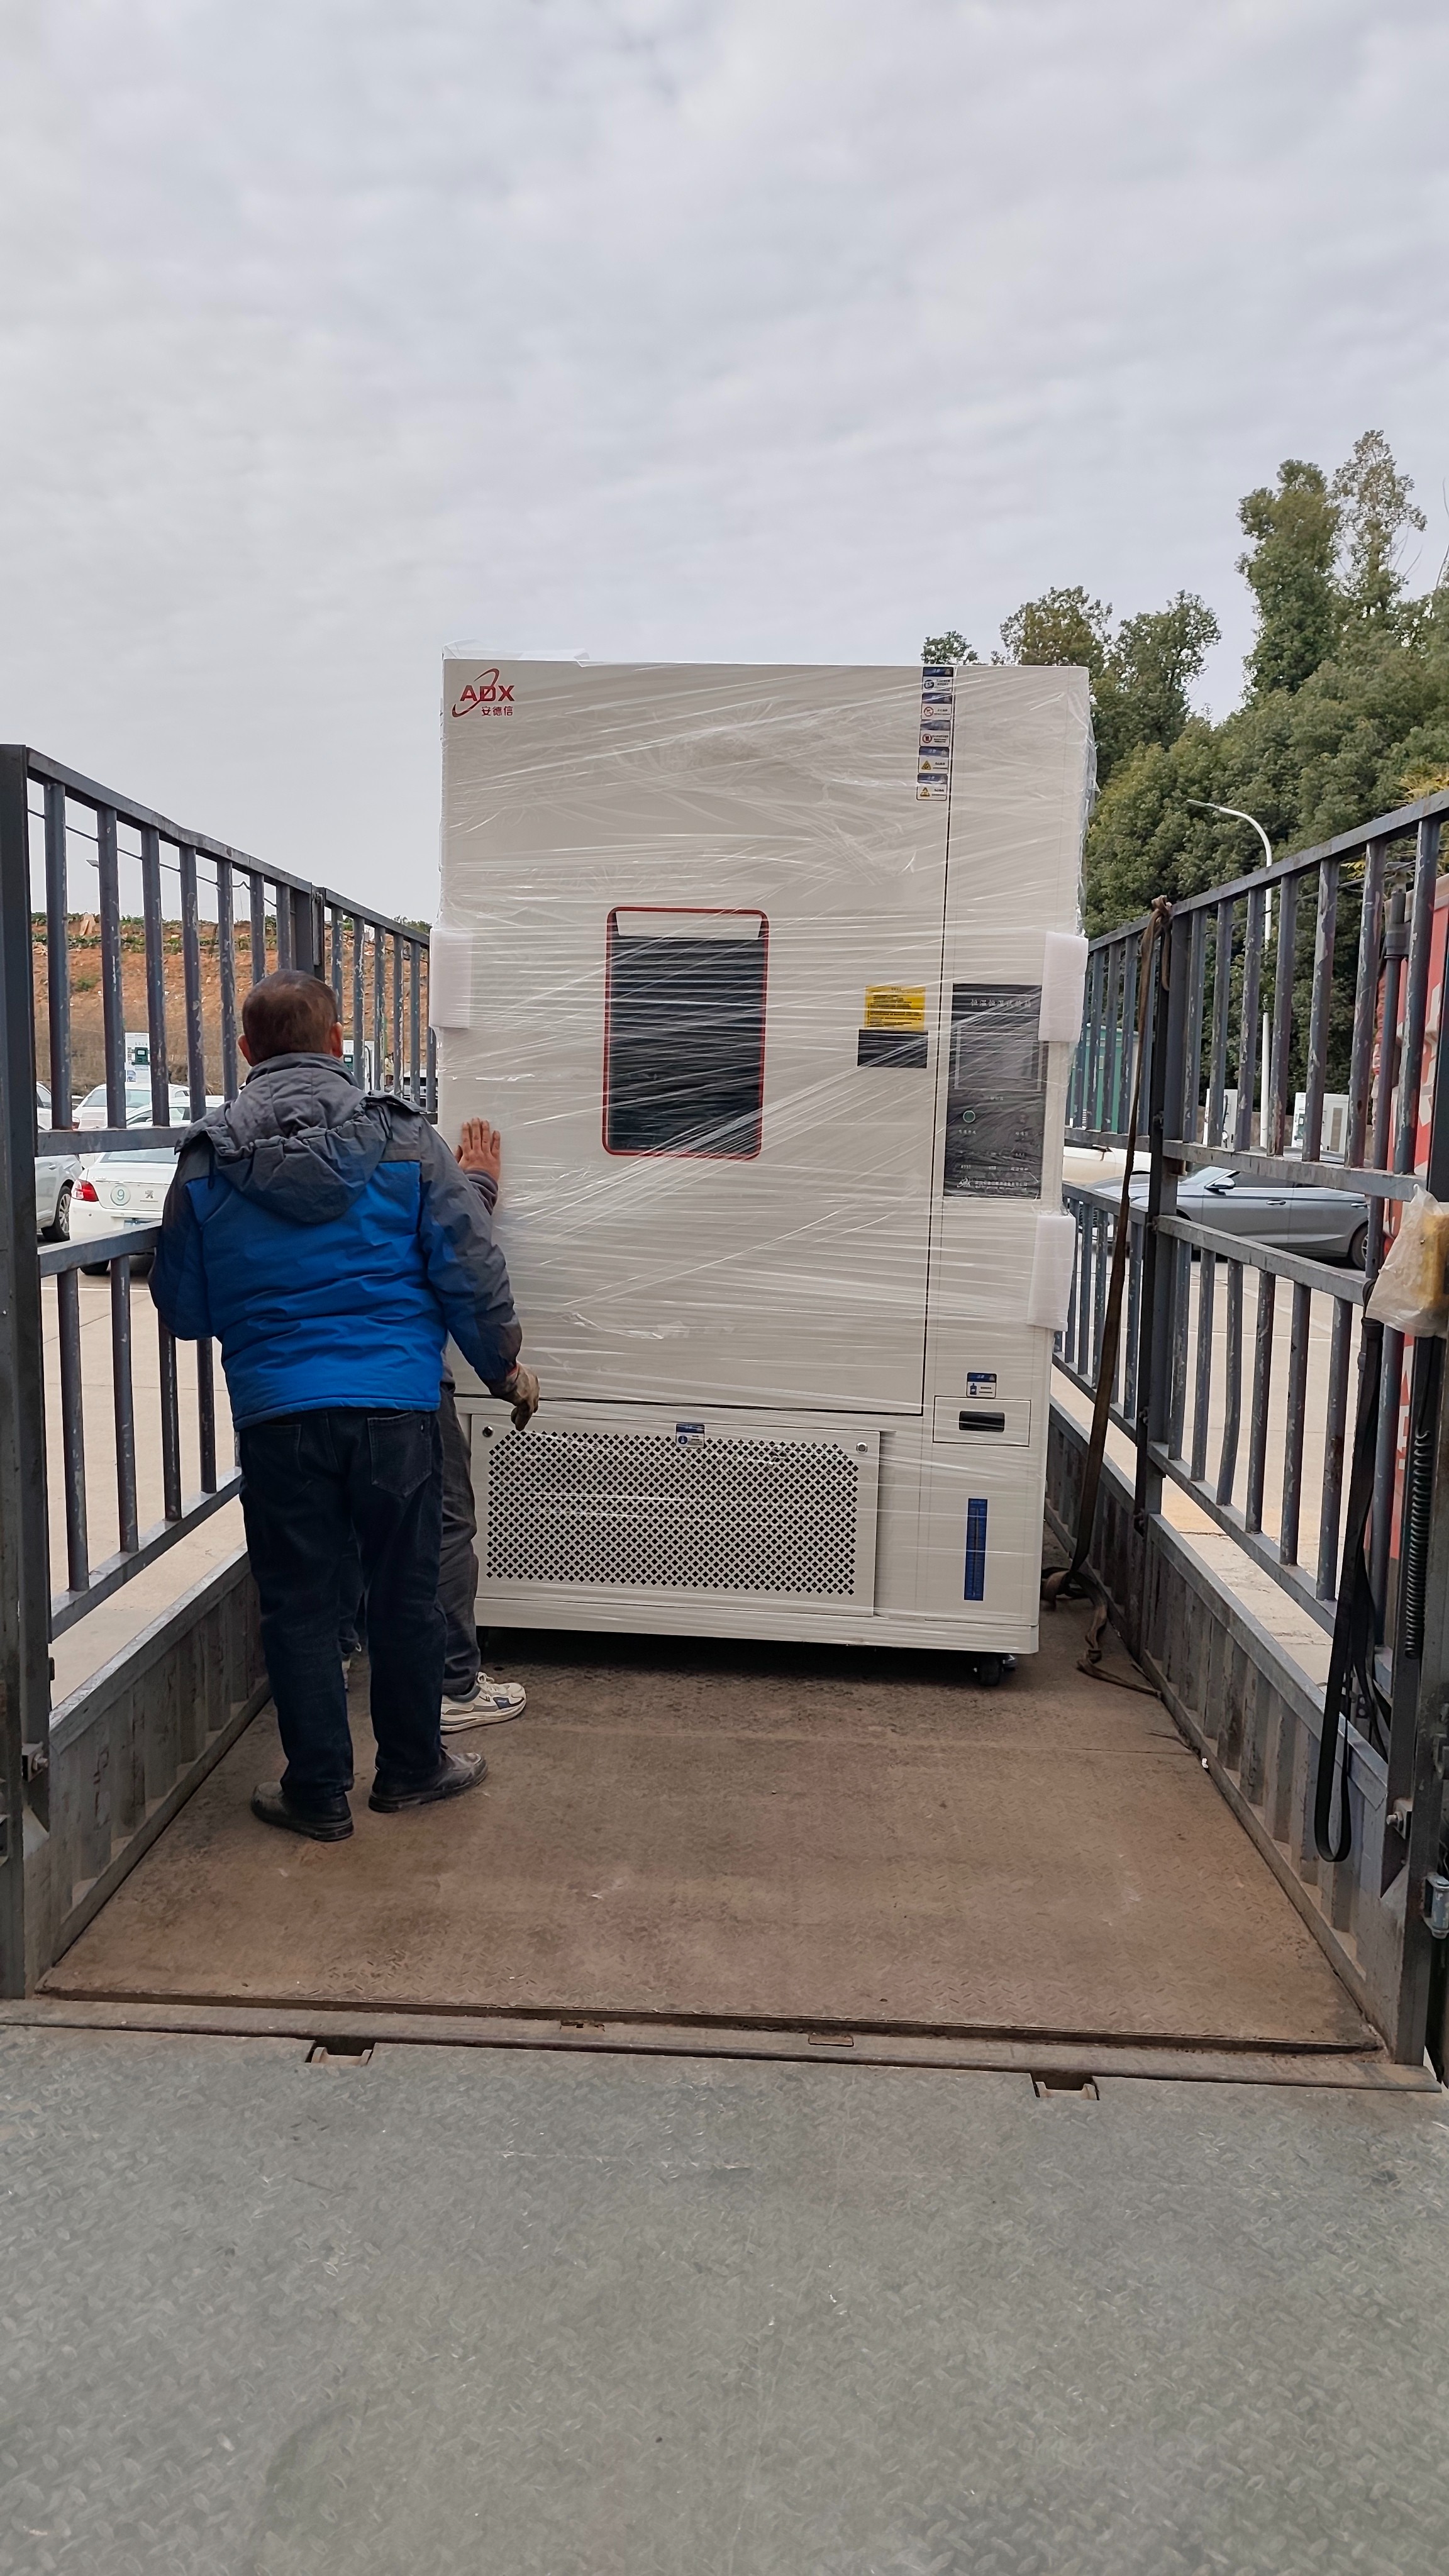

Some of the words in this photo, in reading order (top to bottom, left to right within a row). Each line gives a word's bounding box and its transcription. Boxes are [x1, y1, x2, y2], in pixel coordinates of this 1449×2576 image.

[460, 685, 515, 702] ADX
[481, 706, 513, 716] 安德信
[116, 1189, 125, 1201] 9
